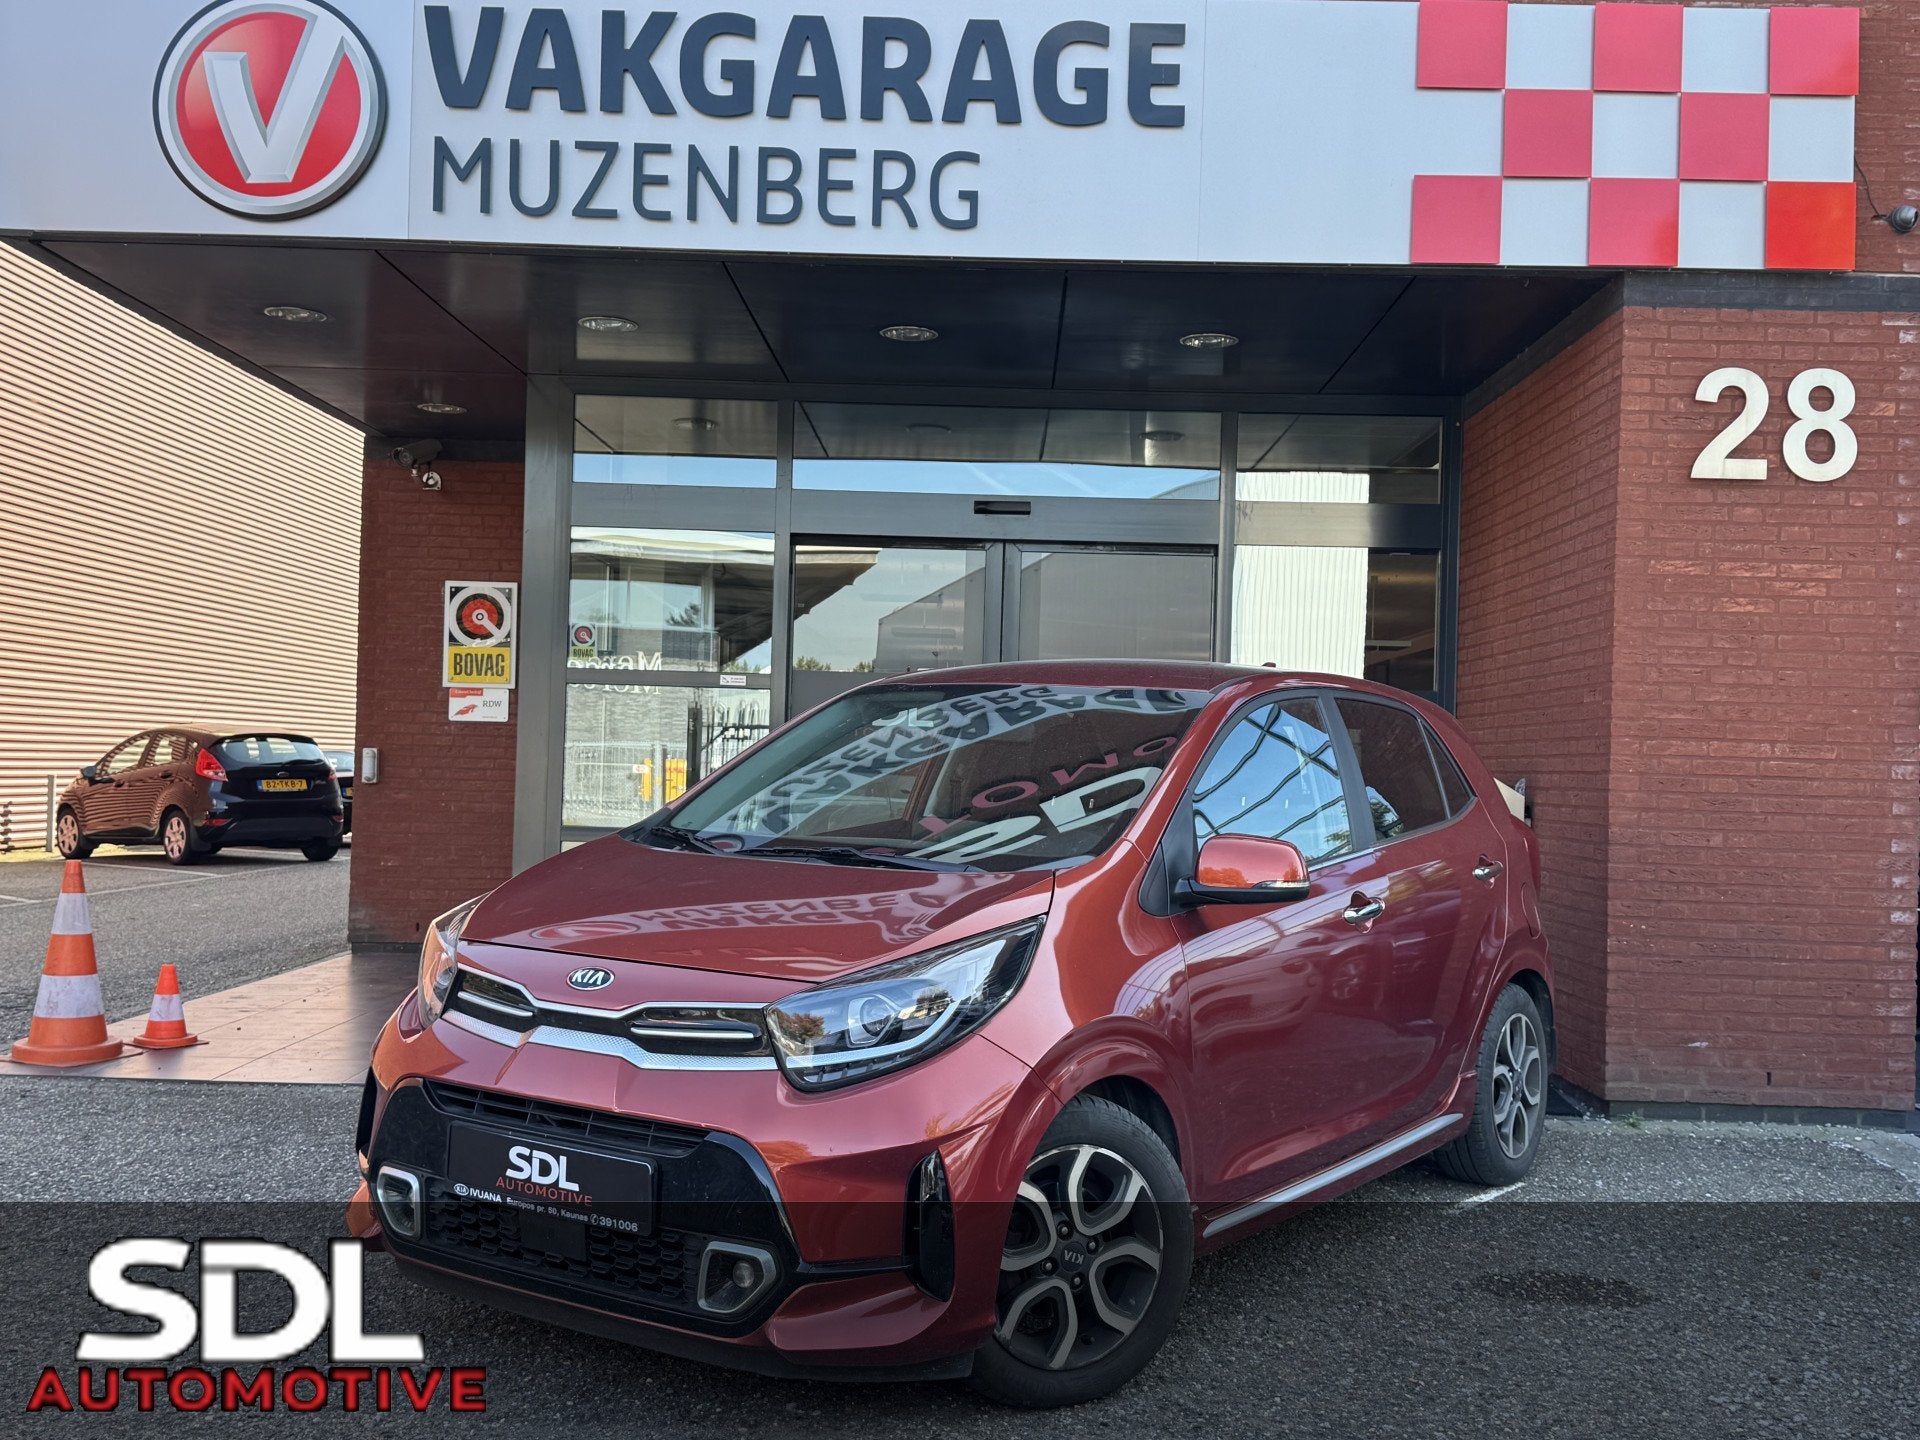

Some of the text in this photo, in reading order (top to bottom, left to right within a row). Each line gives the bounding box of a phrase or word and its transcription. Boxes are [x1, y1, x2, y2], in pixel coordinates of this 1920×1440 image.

[424, 5, 1186, 127] VAKGARAGE
[432, 136, 980, 229] MUZENBERG
[1691, 367, 1858, 482] 28
[453, 653, 505, 677] BOVAG
[482, 700, 502, 708] RDW
[569, 968, 608, 987] KIA
[505, 1145, 580, 1192] SDL
[455, 1185, 468, 1194] KIA
[470, 1187, 502, 1203] IVUANA
[506, 1196, 535, 1211] Europos
[560, 1208, 589, 1222] Kaunas
[599, 1216, 638, 1232] 391006
[496, 1176, 593, 1207] AUTOMOTIVE
[1063, 1249, 1085, 1265] KIA
